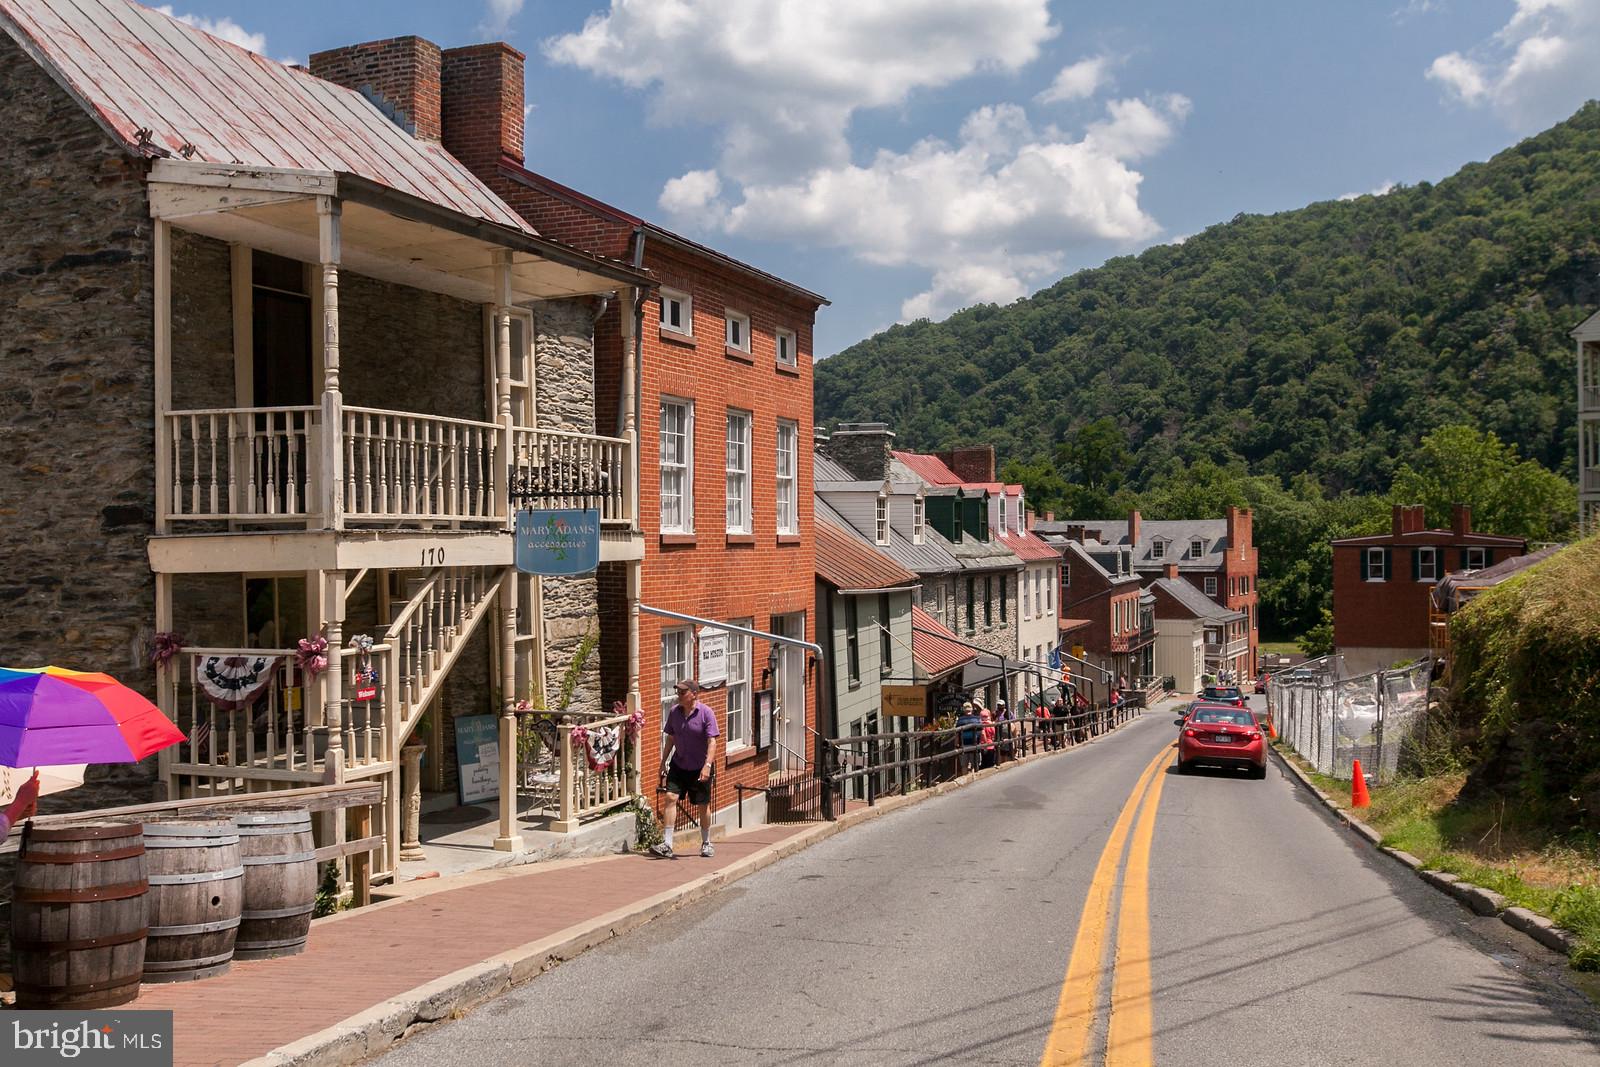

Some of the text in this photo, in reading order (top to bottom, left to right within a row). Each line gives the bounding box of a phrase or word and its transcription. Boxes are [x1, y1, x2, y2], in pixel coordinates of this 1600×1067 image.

[521, 525, 595, 536] MARY ADAMS
[528, 540, 586, 549] accessories
[421, 547, 445, 566] 170
